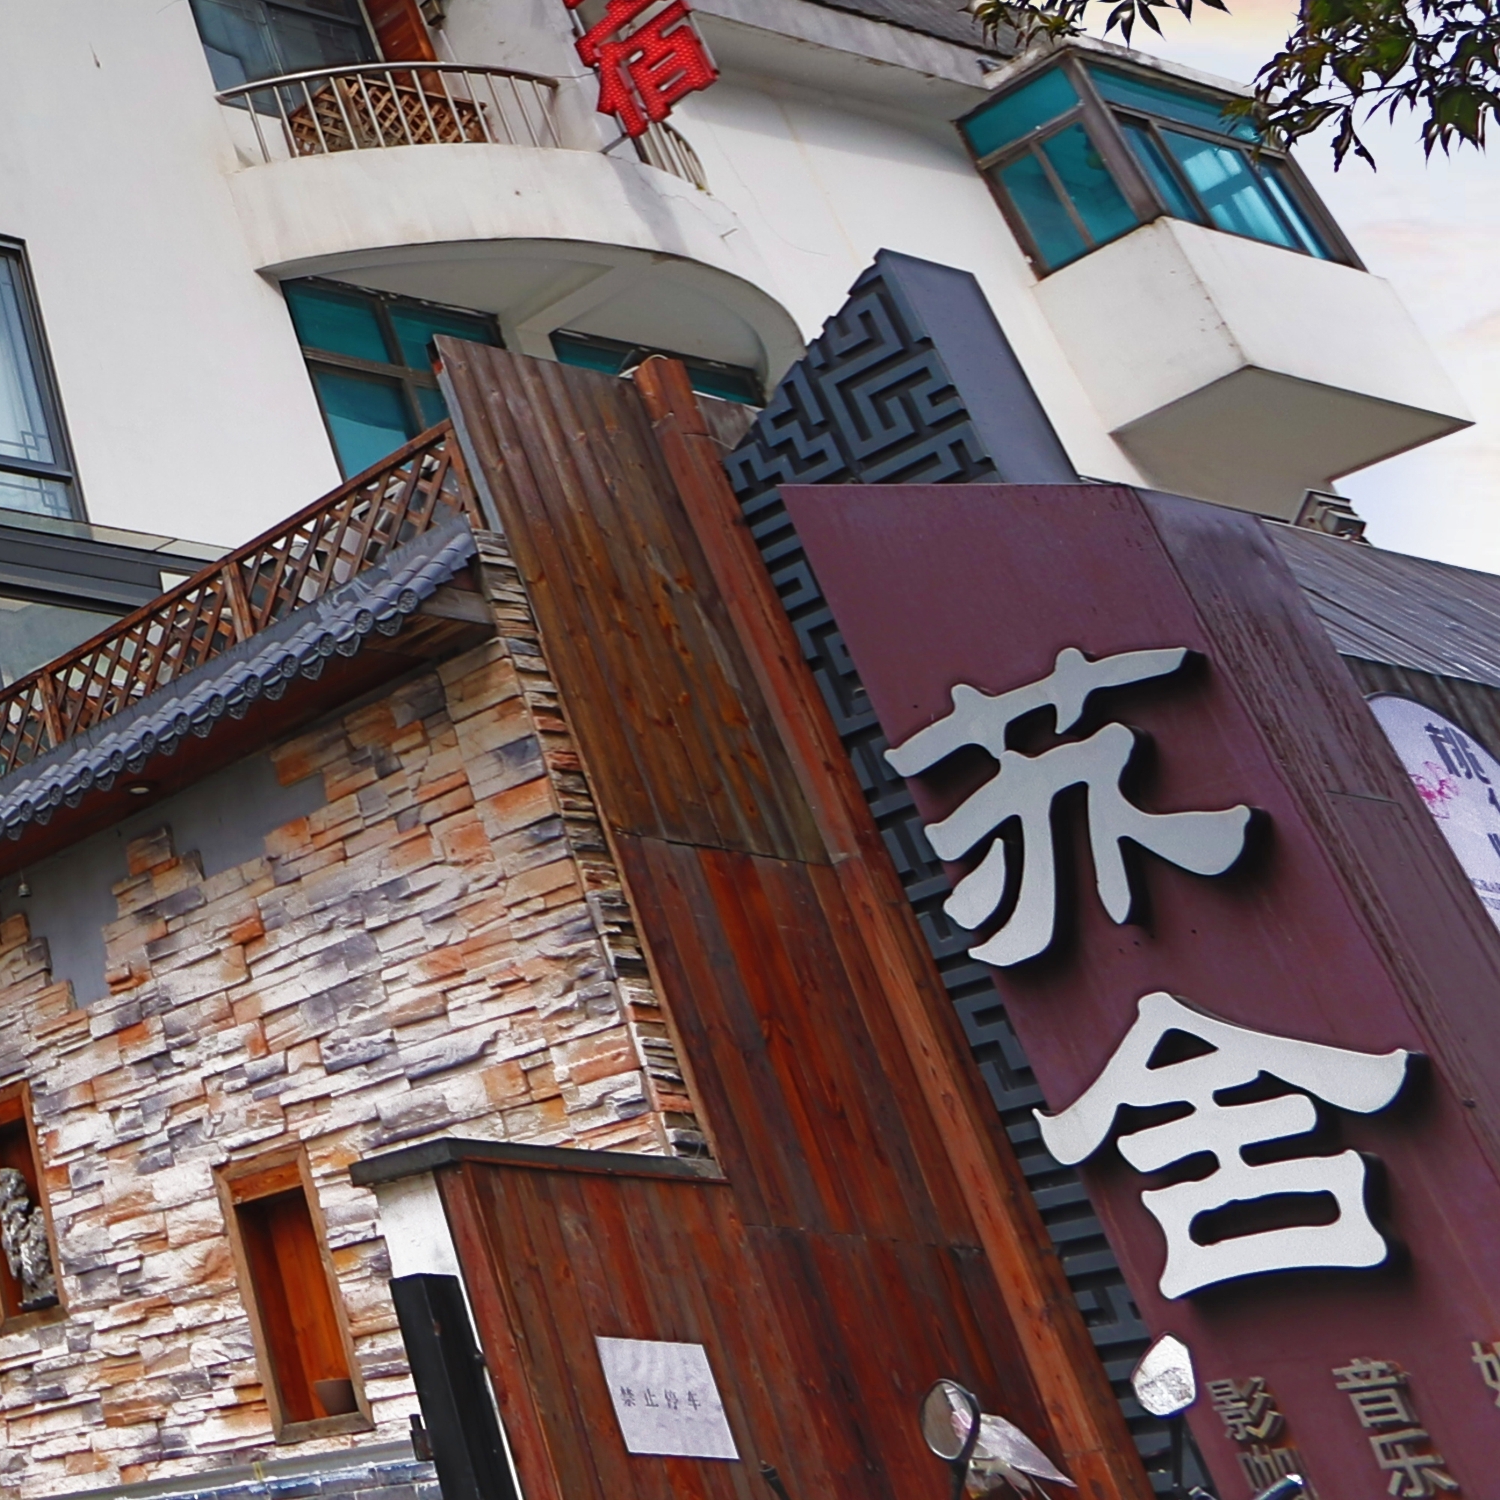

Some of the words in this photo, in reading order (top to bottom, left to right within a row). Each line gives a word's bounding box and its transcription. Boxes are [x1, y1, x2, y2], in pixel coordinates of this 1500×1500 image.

[883, 646, 1414, 1300] 苏舍
[619, 1385, 702, 1411] 禁止停车
[1331, 1357, 1462, 1499] 音乐
